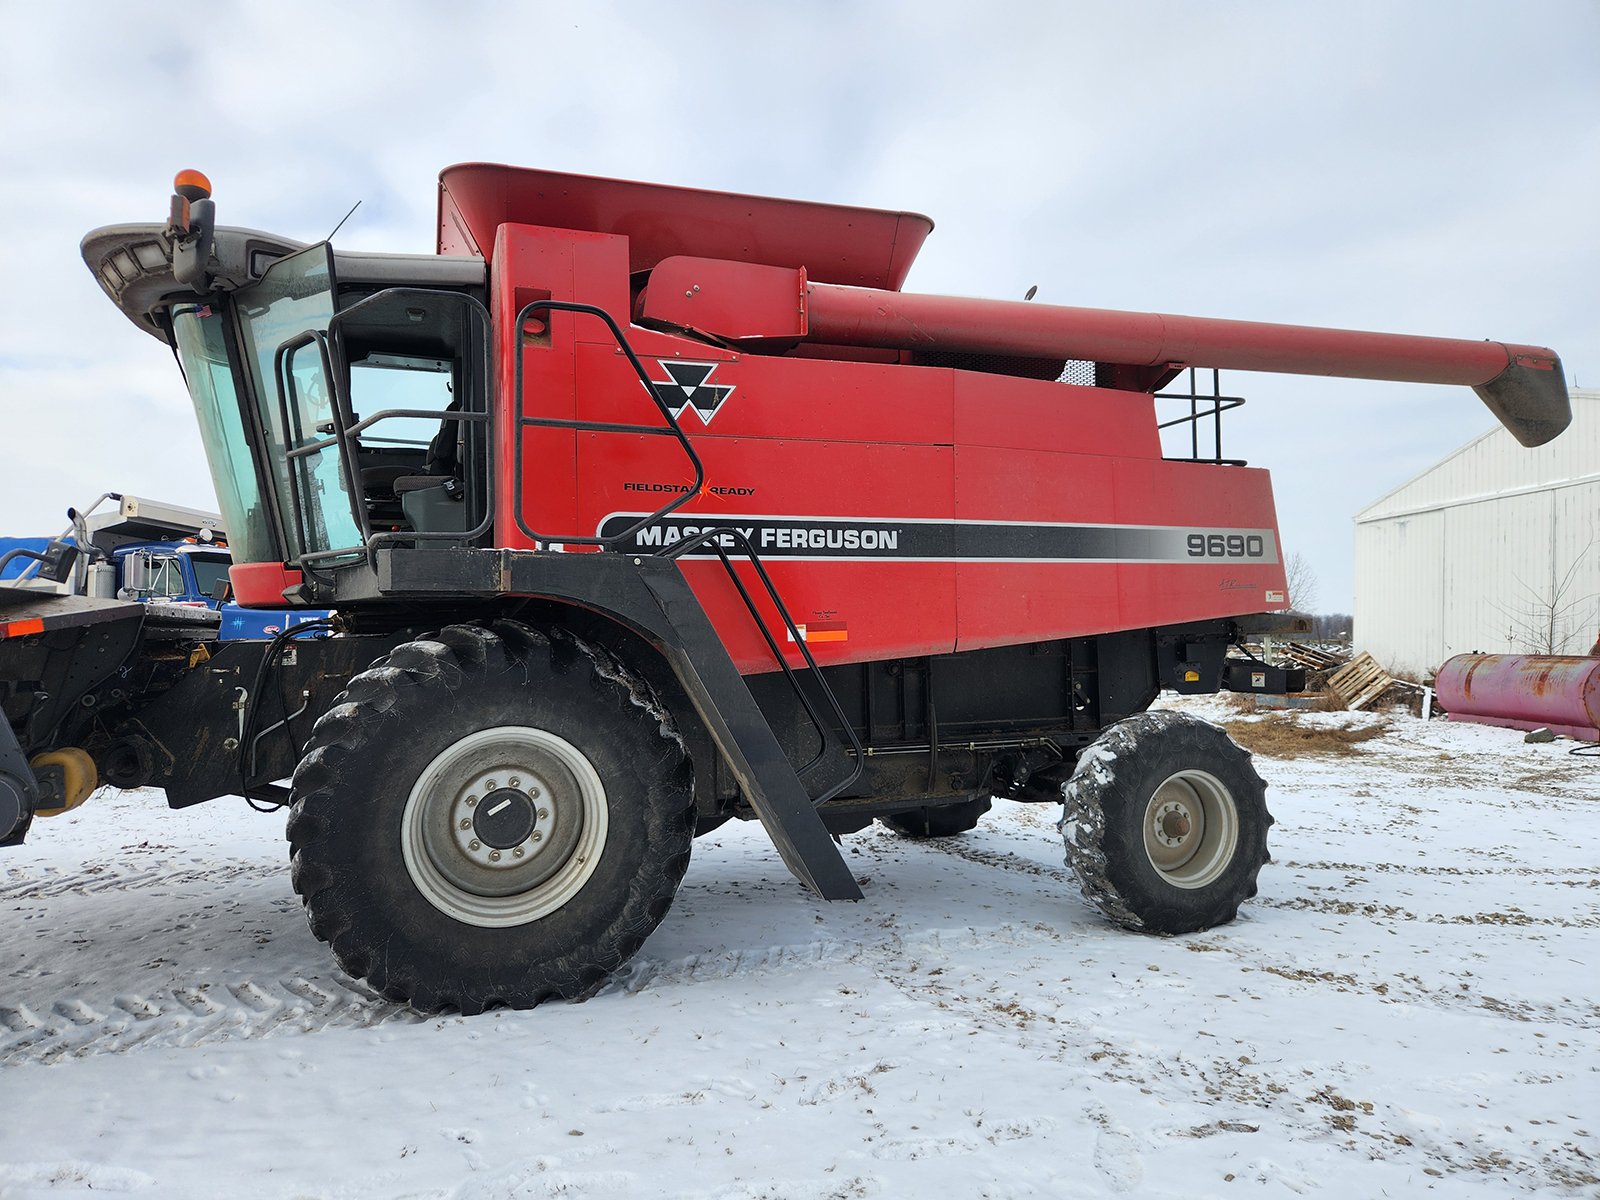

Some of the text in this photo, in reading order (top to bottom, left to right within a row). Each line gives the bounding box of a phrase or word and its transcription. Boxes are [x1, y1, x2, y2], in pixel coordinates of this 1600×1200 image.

[623, 483, 755, 496] FIELDSTA READY
[761, 528, 898, 549] FERGUSON
[1187, 534, 1263, 557] 9690
